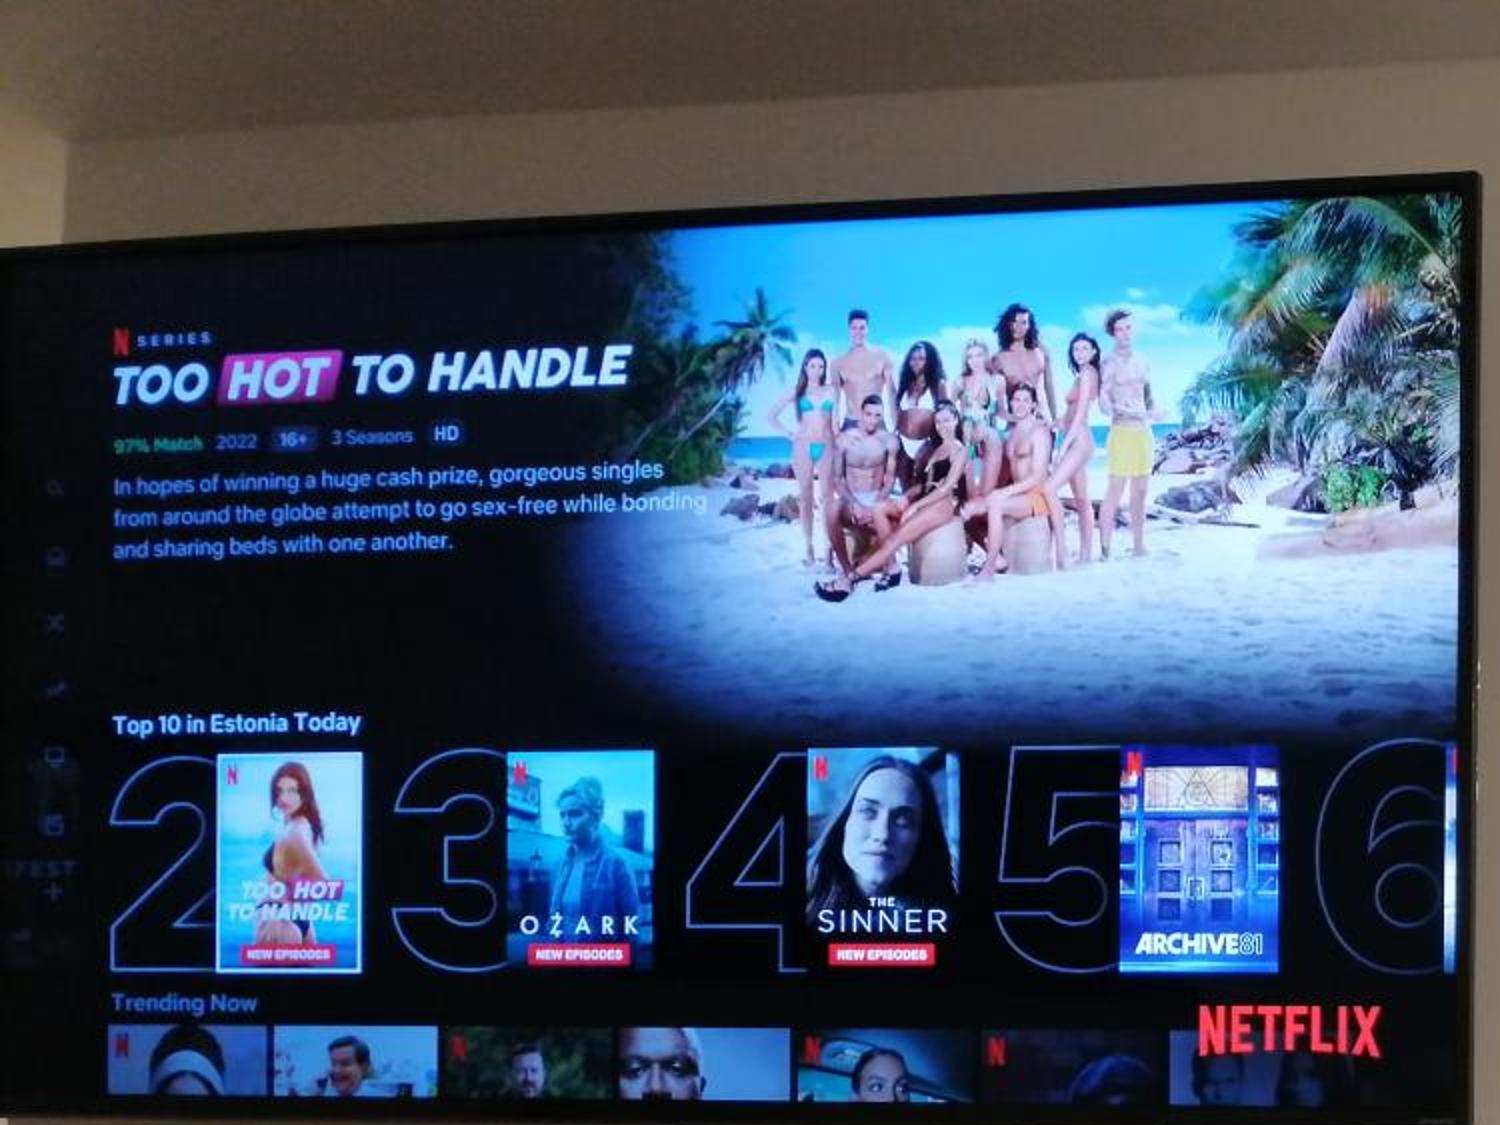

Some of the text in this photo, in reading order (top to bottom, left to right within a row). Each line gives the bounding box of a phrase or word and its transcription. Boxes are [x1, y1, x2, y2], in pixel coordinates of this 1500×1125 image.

[114, 328, 212, 356] N SERIES
[113, 345, 633, 405] TOO HOT TO HANDLE
[113, 425, 459, 455] 97% Match 2022 16+ 3 Seasons HD
[114, 460, 665, 498] In hopes of winning a huge cash prize, gorgeous singles
[113, 491, 708, 527] from around the globe attempt to go sex-free while bonding
[113, 531, 454, 561] and sharing beds with one another.
[112, 710, 362, 739] Top 10 in Estonia Today
[109, 754, 218, 972] 2
[391, 747, 507, 973] 3
[685, 751, 808, 973] 4
[994, 745, 1121, 974] 5
[1314, 736, 1446, 975] 6
[241, 880, 341, 900] TOO HOT
[869, 897, 896, 907] THE
[229, 902, 350, 921] TO HANDLE
[520, 912, 639, 938] OZARK
[818, 908, 947, 933] SINNER
[536, 949, 624, 961] NEW EPISODES
[837, 949, 928, 961] NEW EPISODES
[111, 992, 257, 1018] Trending Now
[1198, 1005, 1383, 1058] NETFLIX
